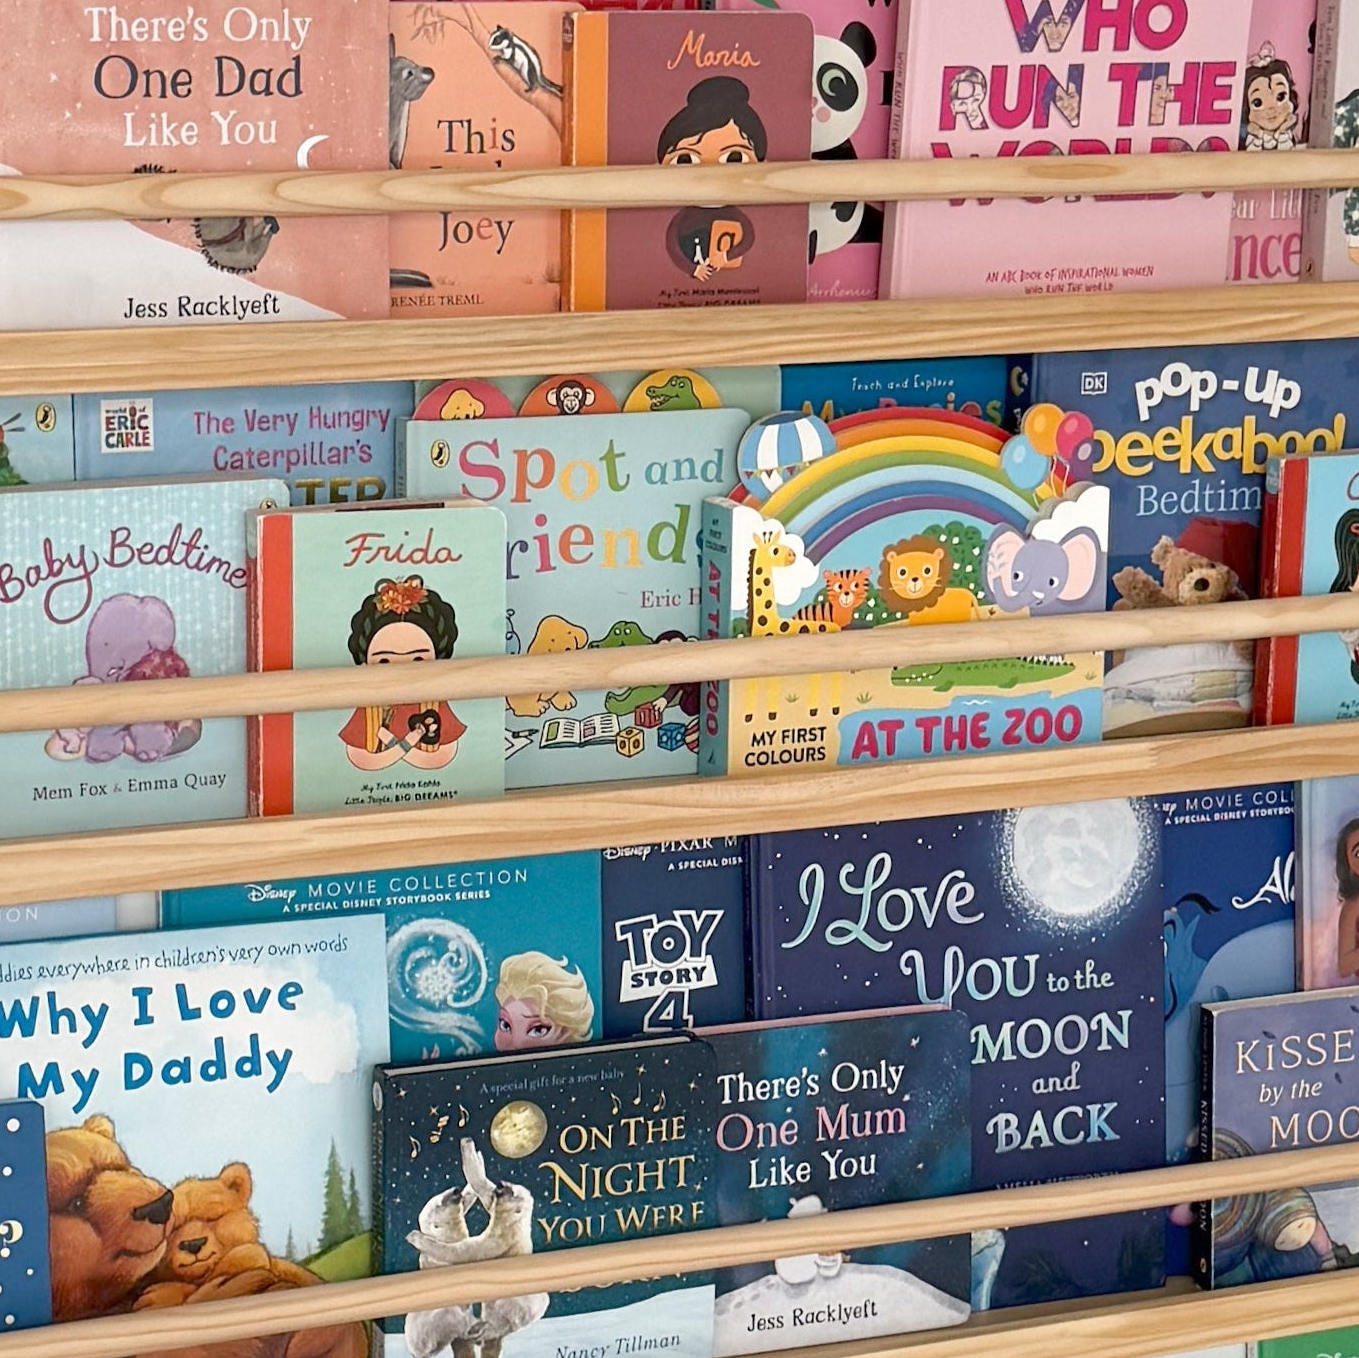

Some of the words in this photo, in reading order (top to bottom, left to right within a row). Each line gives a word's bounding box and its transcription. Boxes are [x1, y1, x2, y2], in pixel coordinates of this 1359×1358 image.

[85, 7, 209, 43] There's
[223, 6, 312, 50] Only
[667, 30, 761, 71] Maria
[94, 55, 192, 98] One
[215, 55, 303, 98] Dad
[124, 111, 199, 148] Like
[210, 111, 278, 146] You
[437, 119, 516, 155] This
[124, 297, 169, 320] Jess
[177, 293, 281, 321] Racklyeft
[104, 411, 149, 433] ERIC
[193, 412, 235, 435] The
[243, 408, 298, 436] Very
[308, 406, 391, 435] Hungry
[104, 429, 152, 450] CARLE
[212, 440, 373, 474] Caterpillar's
[640, 589, 680, 609] Eric
[750, 730, 777, 748] MY
[781, 726, 826, 745] FIRST
[851, 720, 906, 760] AT
[915, 712, 989, 752] THE
[1003, 704, 1083, 745] ZOO
[744, 744, 827, 768] COLOURS
[33, 784, 74, 802] Mem
[79, 781, 107, 798] Fox
[128, 776, 178, 795] Emma
[184, 771, 227, 794] Quay
[1185, 793, 1244, 812] MOVIE
[1165, 816, 1171, 824] A
[1173, 813, 1211, 824] SPECIAL
[1214, 810, 1247, 823] DISNEY
[668, 863, 675, 871] A
[678, 859, 718, 870] SPECIAL
[246, 884, 297, 903] Disney
[307, 878, 378, 897] MOVIE
[388, 868, 528, 893] COLLECTION
[282, 904, 291, 913] A
[292, 900, 339, 912] SPECIAL
[342, 897, 382, 910] DISNEY
[386, 893, 451, 908] STORYBOOK
[454, 889, 491, 902] SERIES
[37, 954, 131, 985] everywhere
[133, 953, 151, 969] in
[154, 942, 225, 969] children's
[227, 942, 264, 965] very
[268, 942, 301, 958] own
[303, 935, 348, 956] words
[630, 965, 709, 990] STORY
[132, 986, 155, 1027] I
[176, 978, 305, 1023] Love
[717, 1072, 819, 1105] There's
[830, 1060, 905, 1096] Only
[1032, 1061, 1080, 1095] and
[1258, 1084, 1284, 1105] by
[1290, 1079, 1322, 1100] the
[559, 1124, 613, 1156] ON
[618, 1116, 687, 1147] THE
[716, 1112, 798, 1152] One
[814, 1103, 908, 1141] Mum
[748, 1160, 812, 1189] Like
[822, 1150, 877, 1182] You
[538, 1214, 607, 1245] YOU
[613, 1203, 706, 1237] WERE
[747, 1308, 787, 1334] Jess
[792, 1298, 878, 1331] Racklyeft
[614, 1331, 681, 1358] Tillman
